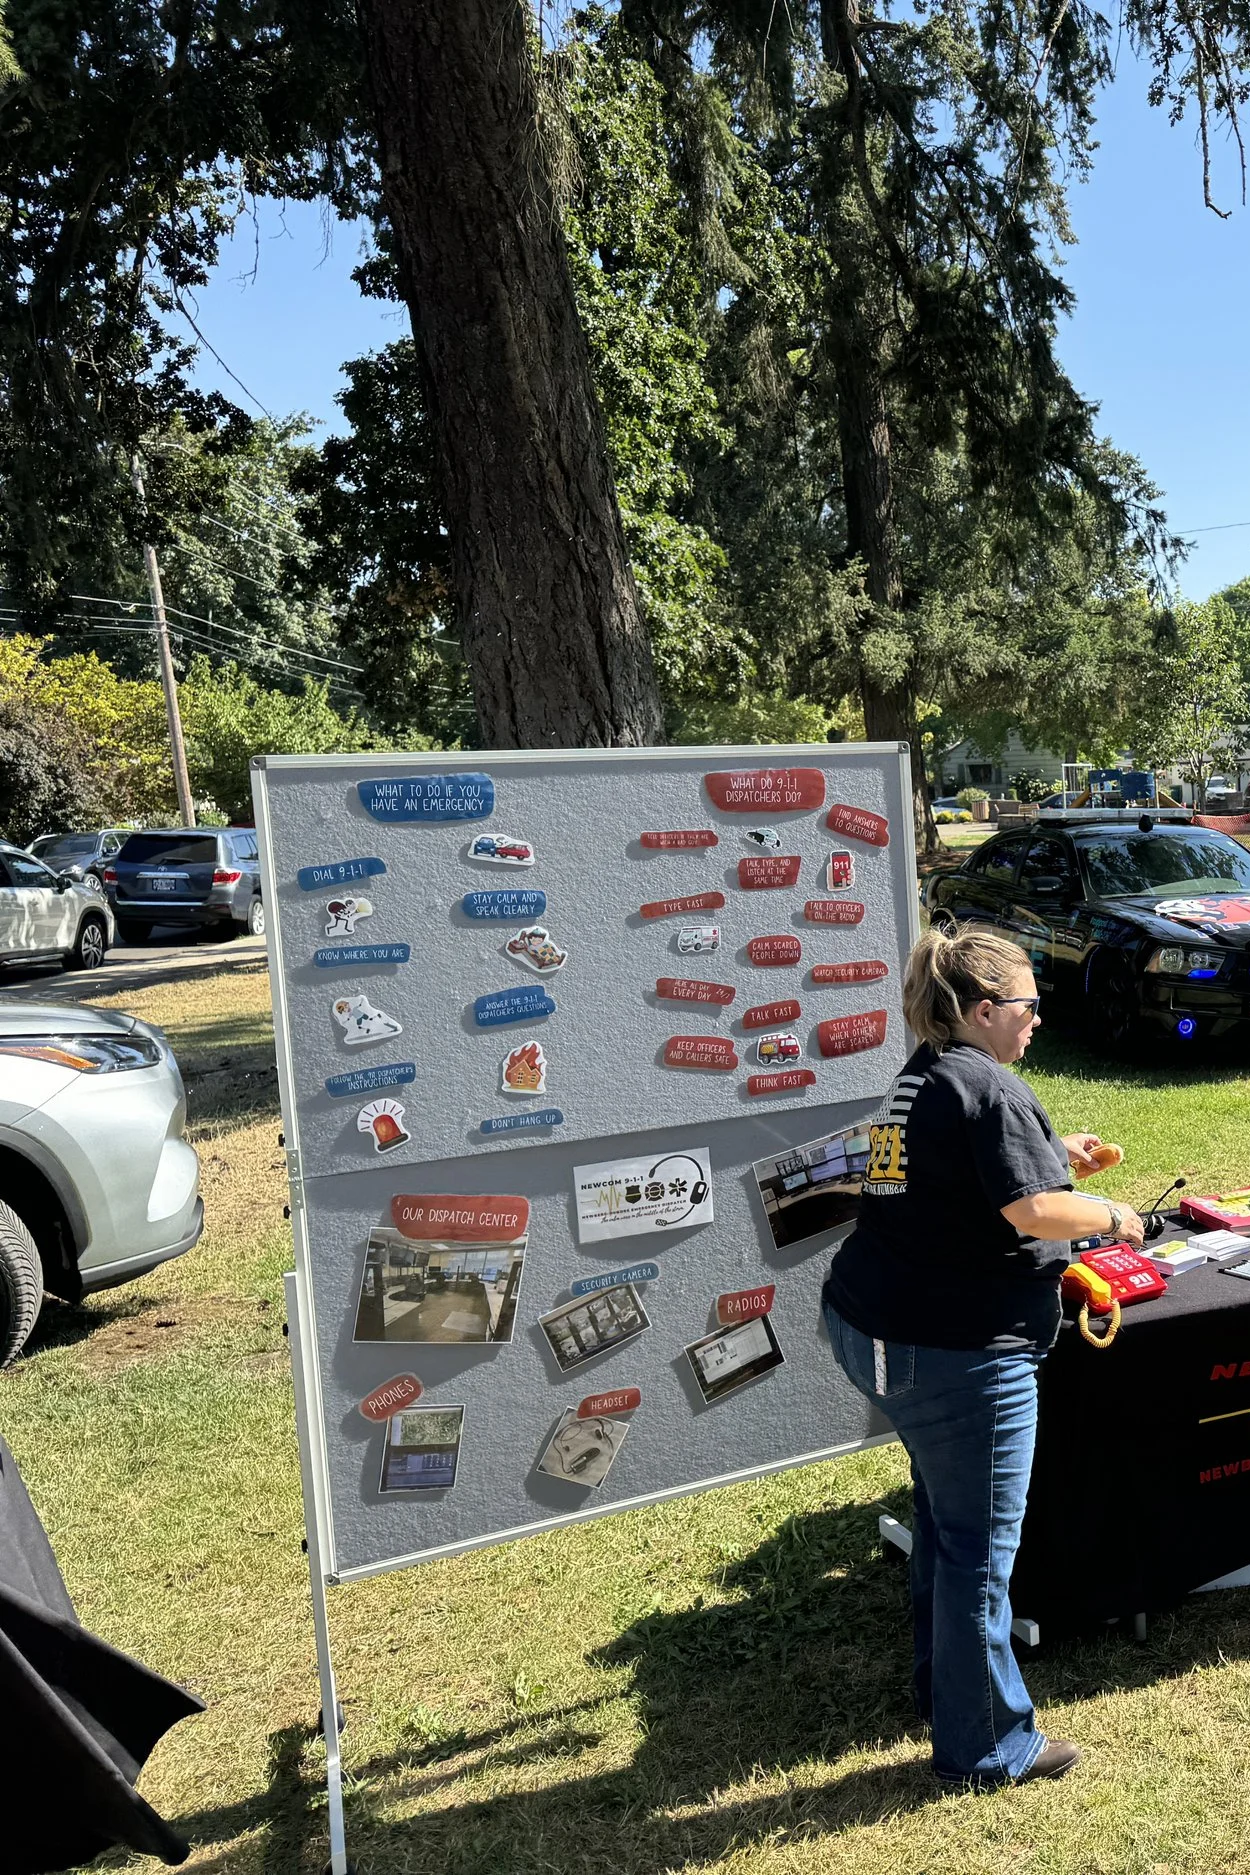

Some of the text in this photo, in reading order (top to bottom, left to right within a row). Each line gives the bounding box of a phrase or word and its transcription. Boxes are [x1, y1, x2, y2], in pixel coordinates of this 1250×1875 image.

[730, 777, 797, 790] WHAT DO 9-1-1
[375, 784, 480, 797] WHAT TO DO IF YOU
[726, 790, 802, 803] DISPATCHERS DO?
[371, 799, 484, 811] HAVE AN EMERGENCY
[838, 808, 879, 831] FIND ANSWERS
[834, 817, 877, 841] TO QUESTIONS
[780, 858, 791, 866] AND
[834, 861, 849, 870] 911
[313, 864, 363, 881] DIAL 9-1-1
[747, 867, 787, 876] LISTEN AT THE
[753, 875, 784, 885] SAME TIME
[473, 893, 537, 905] STAY CALM AND
[663, 899, 704, 912] TYPE FAST
[476, 904, 535, 916] SPEAK CLEARLY
[810, 902, 861, 913] TALK TO OFFICERS
[814, 911, 856, 922] ON THE RADIO
[752, 940, 798, 951] CALM SCARED
[318, 948, 405, 961] KNOW WHERE YOU ARE
[752, 949, 799, 960] PEOPLE DOWN
[813, 966, 886, 977] WATCH SECURITY CAMERAS
[674, 979, 687, 988] HERE
[699, 983, 710, 991] DAY
[673, 987, 712, 1001] EVERY DAY
[485, 1000, 508, 1010] ANSWER
[511, 997, 521, 1006] THE
[516, 1002, 547, 1014] QUESTIONS
[751, 1006, 792, 1021] TALK FAST
[833, 1017, 870, 1032] STAY CALM
[829, 1024, 877, 1041] WHEN OTHERS
[676, 1040, 727, 1054] KEEP OFFICERS
[834, 1035, 874, 1050] ARE SCARED
[669, 1050, 730, 1065] AND CALLERS SAFE
[330, 1075, 352, 1085] FOLLOW
[347, 1075, 398, 1091] INSTRUCTIONS
[755, 1074, 801, 1089] THINK FAST
[491, 1114, 556, 1129] DON'T HANG UP
[865, 1125, 906, 1180] 911
[581, 1175, 644, 1191] NEWCOM 9-1-1
[402, 1207, 518, 1228] OUR DISPATCH CENTER
[581, 1267, 652, 1291] SECURITY CAMERA
[1128, 1272, 1154, 1286] 911
[727, 1294, 767, 1314] RADIOS
[368, 1379, 415, 1415] PHONES
[591, 1395, 629, 1410] HEADSET
